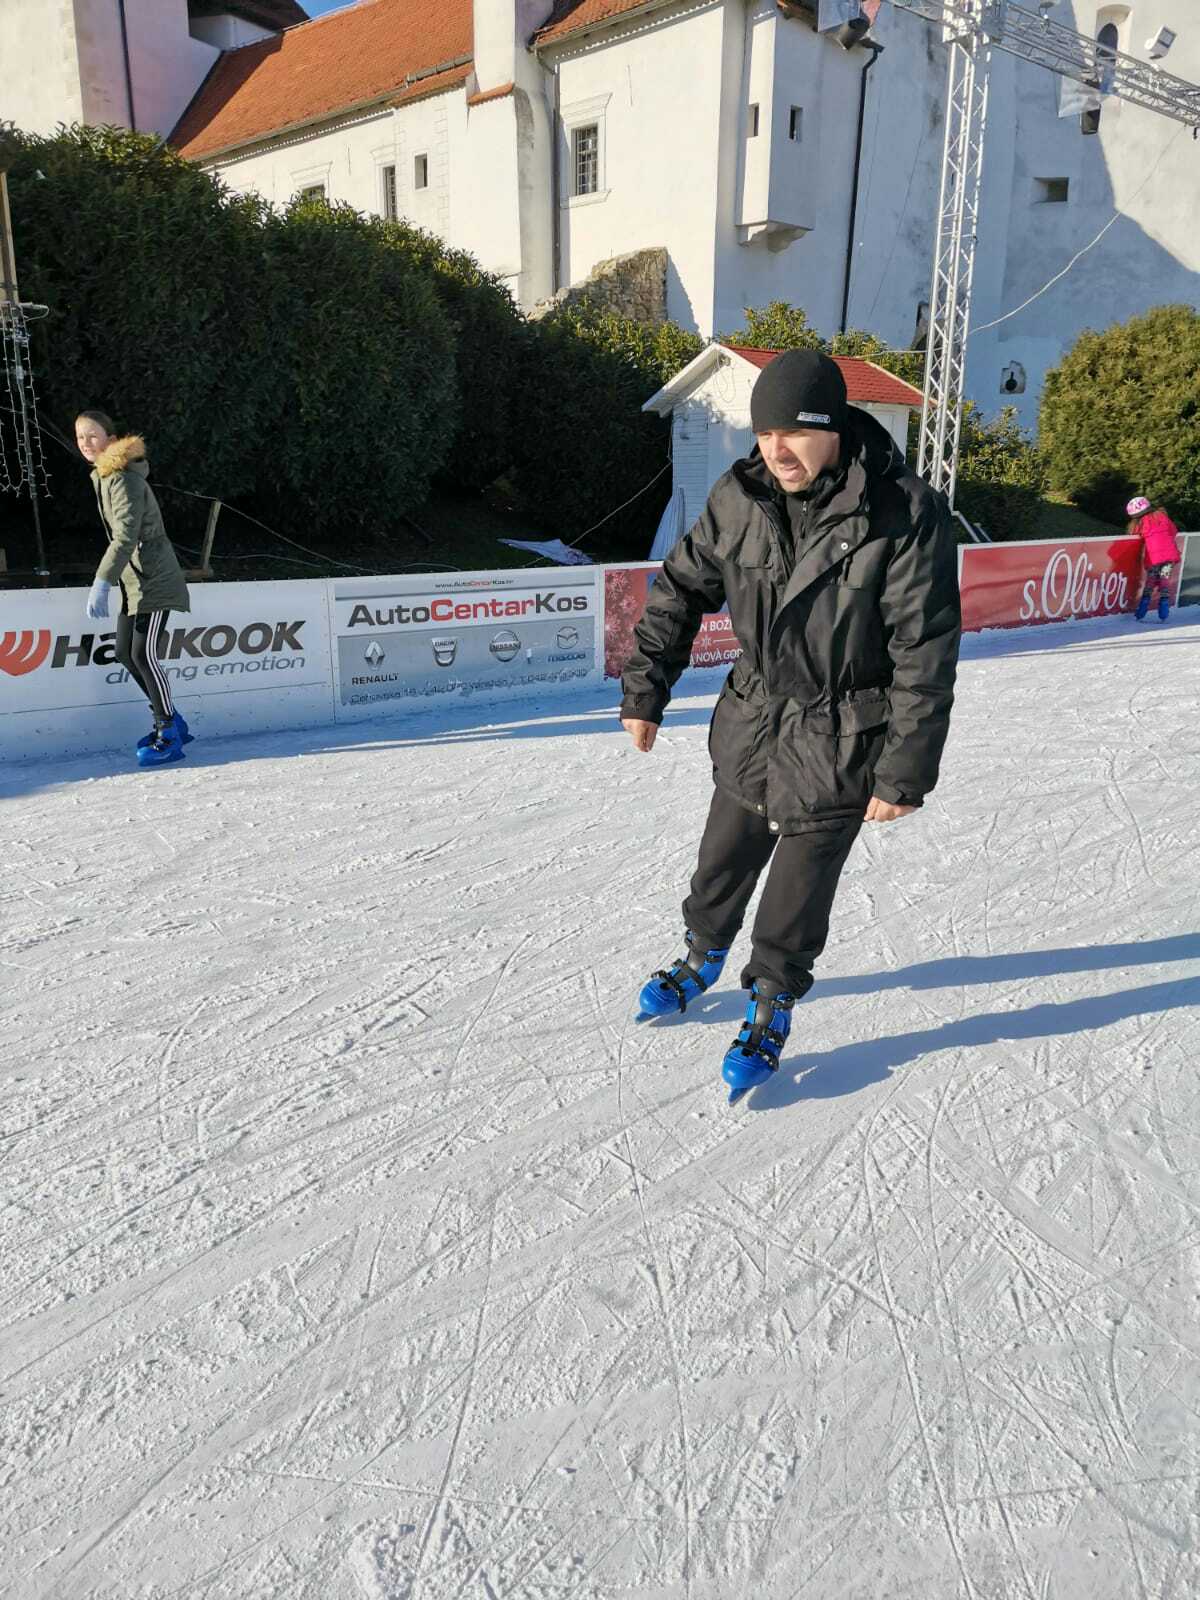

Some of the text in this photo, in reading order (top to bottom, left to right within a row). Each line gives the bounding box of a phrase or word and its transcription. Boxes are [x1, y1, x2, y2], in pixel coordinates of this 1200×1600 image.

[1019, 548, 1128, 620] s.Oliver
[347, 592, 588, 627] AutoCentarKos
[709, 616, 732, 631] BOŽI
[723, 648, 744, 659] GOD
[203, 655, 305, 676] emotion
[351, 672, 399, 686] RENAULT
